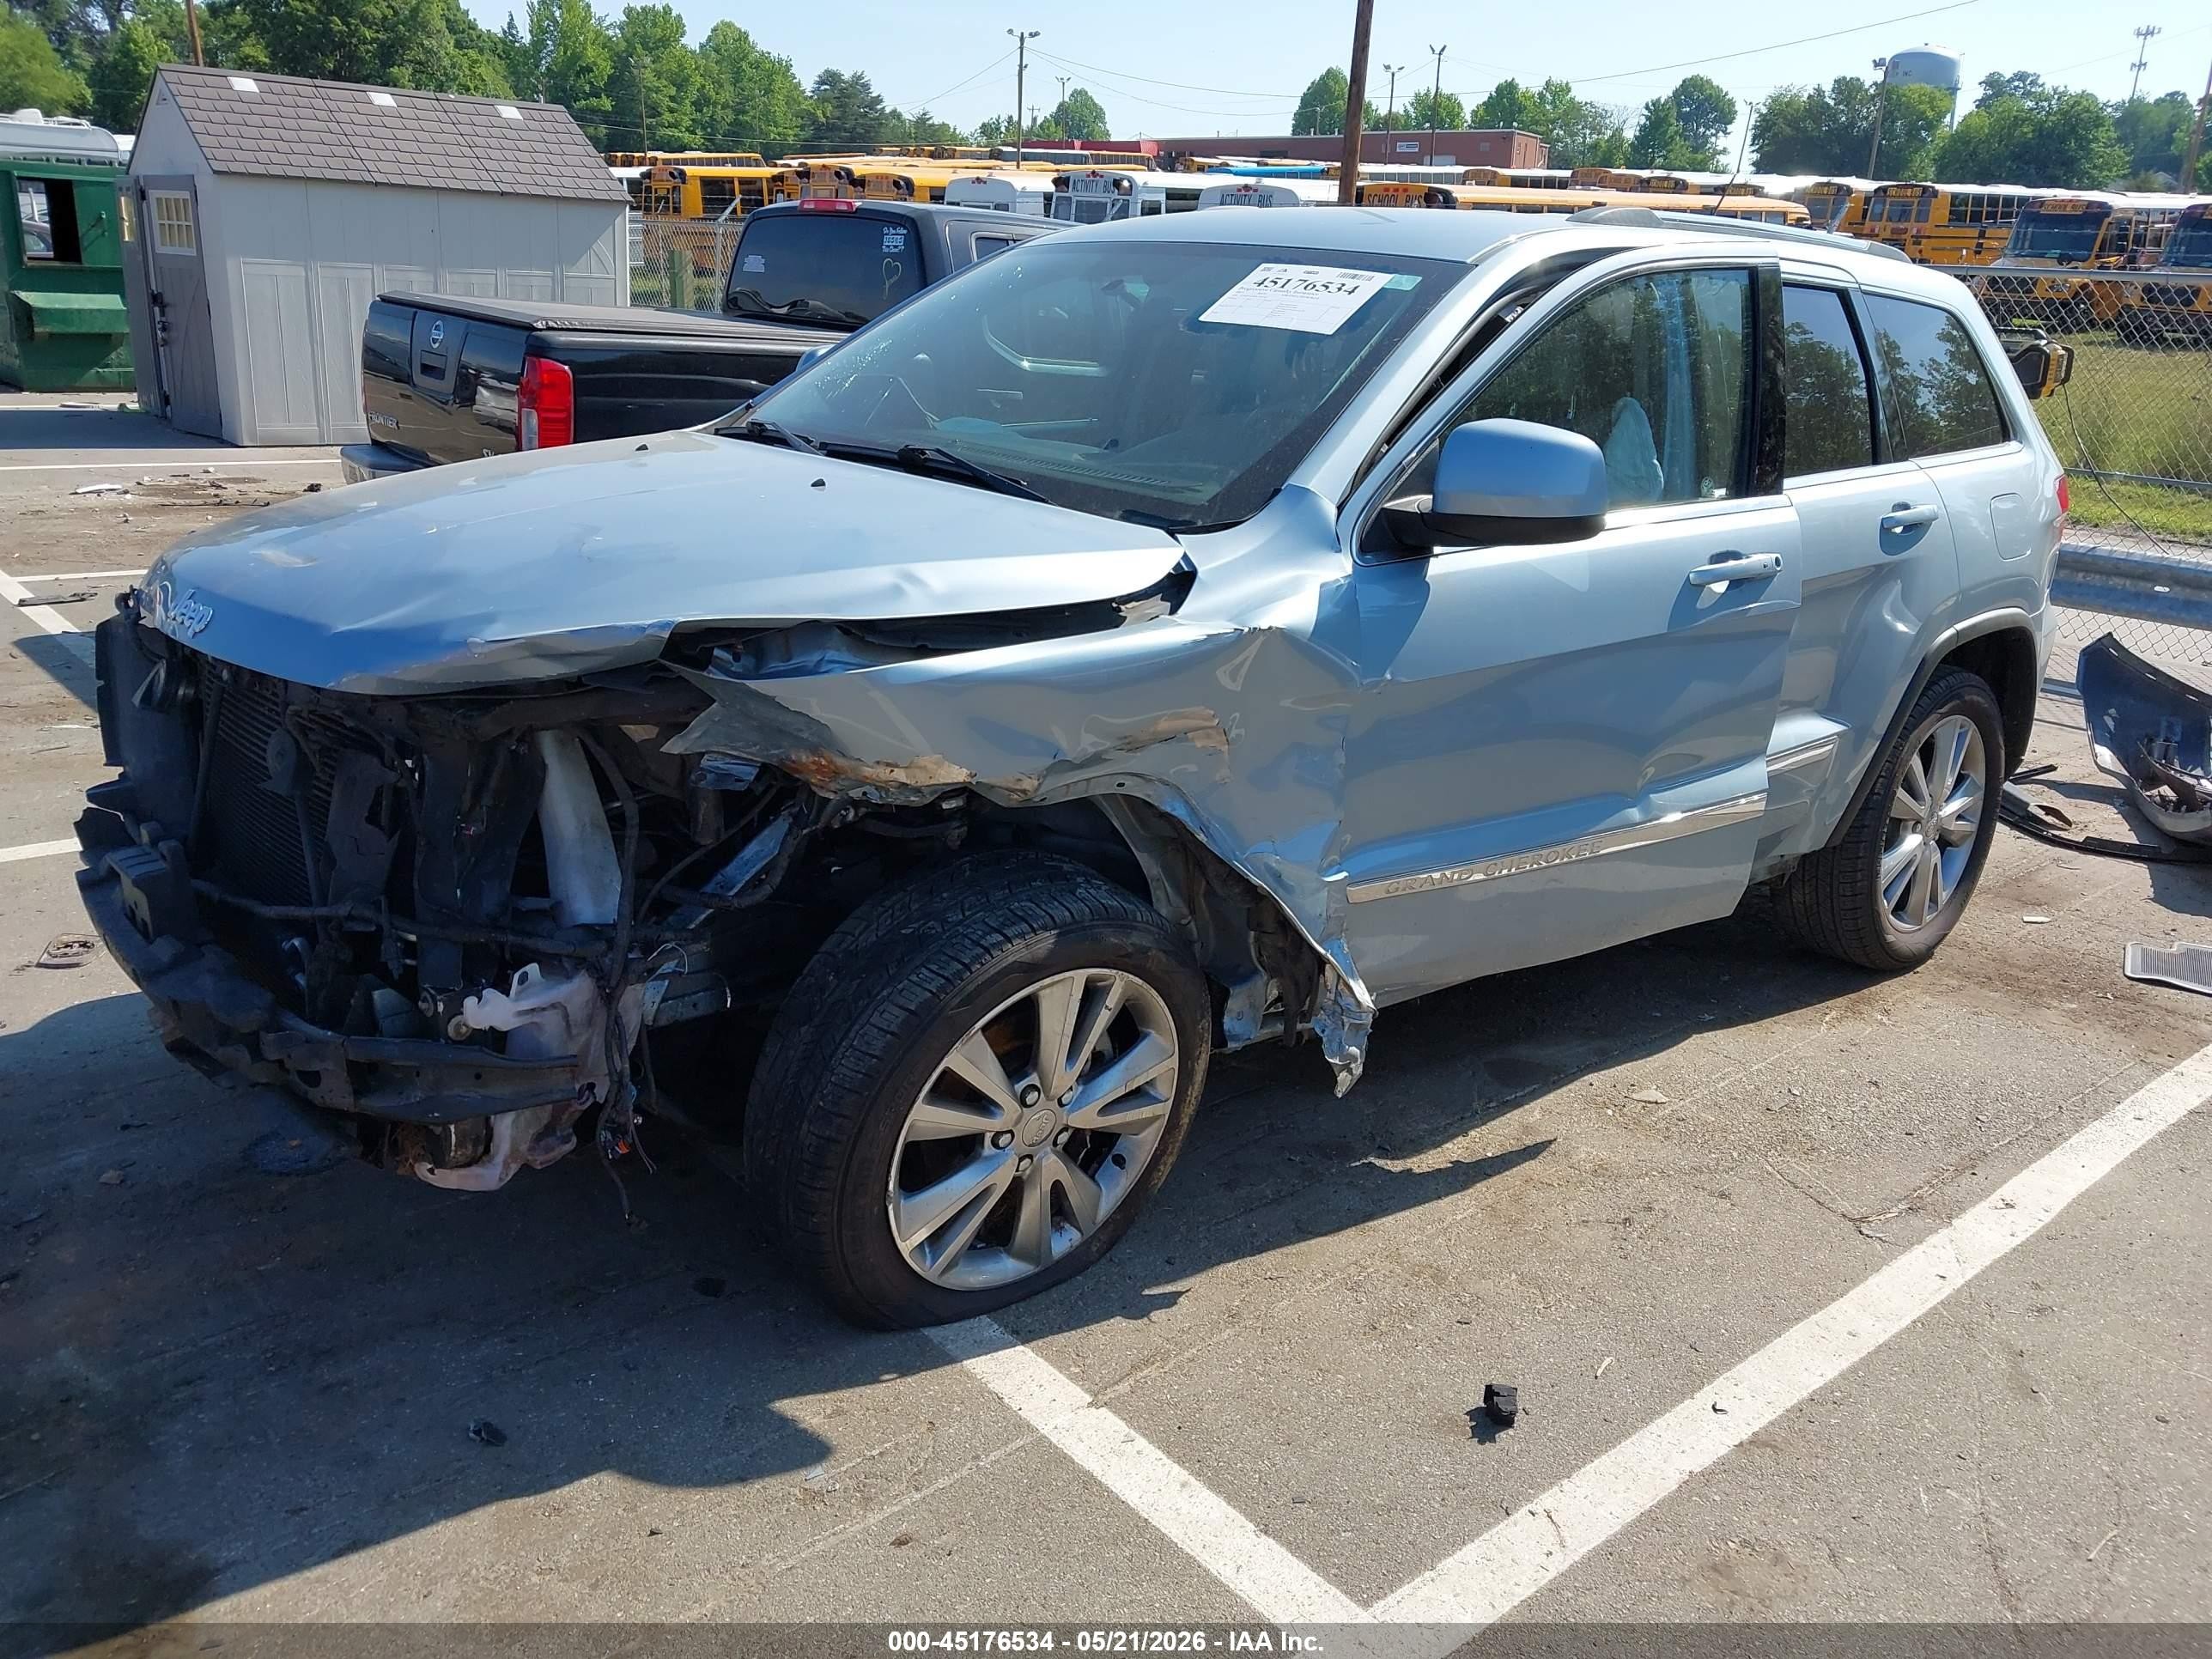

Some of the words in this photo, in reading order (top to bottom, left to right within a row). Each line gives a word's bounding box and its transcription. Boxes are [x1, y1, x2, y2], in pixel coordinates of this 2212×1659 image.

[1072, 179, 1098, 194] ACTIVITY
[1103, 179, 1115, 194] BUS
[1219, 193, 1252, 206] ACTIVITY
[1257, 193, 1273, 207] BUS
[1367, 193, 1399, 207] SCHOOL
[1404, 193, 1423, 207] BUS
[2044, 202, 2066, 212] SCHOOL
[2068, 203, 2085, 212] BUS
[1253, 276, 1361, 295] 45176534
[369, 412, 400, 430] FRONTIER
[167, 589, 213, 638] Jeep
[1385, 867, 1474, 895] GRAND
[1484, 840, 1603, 878] CHEROKEE
